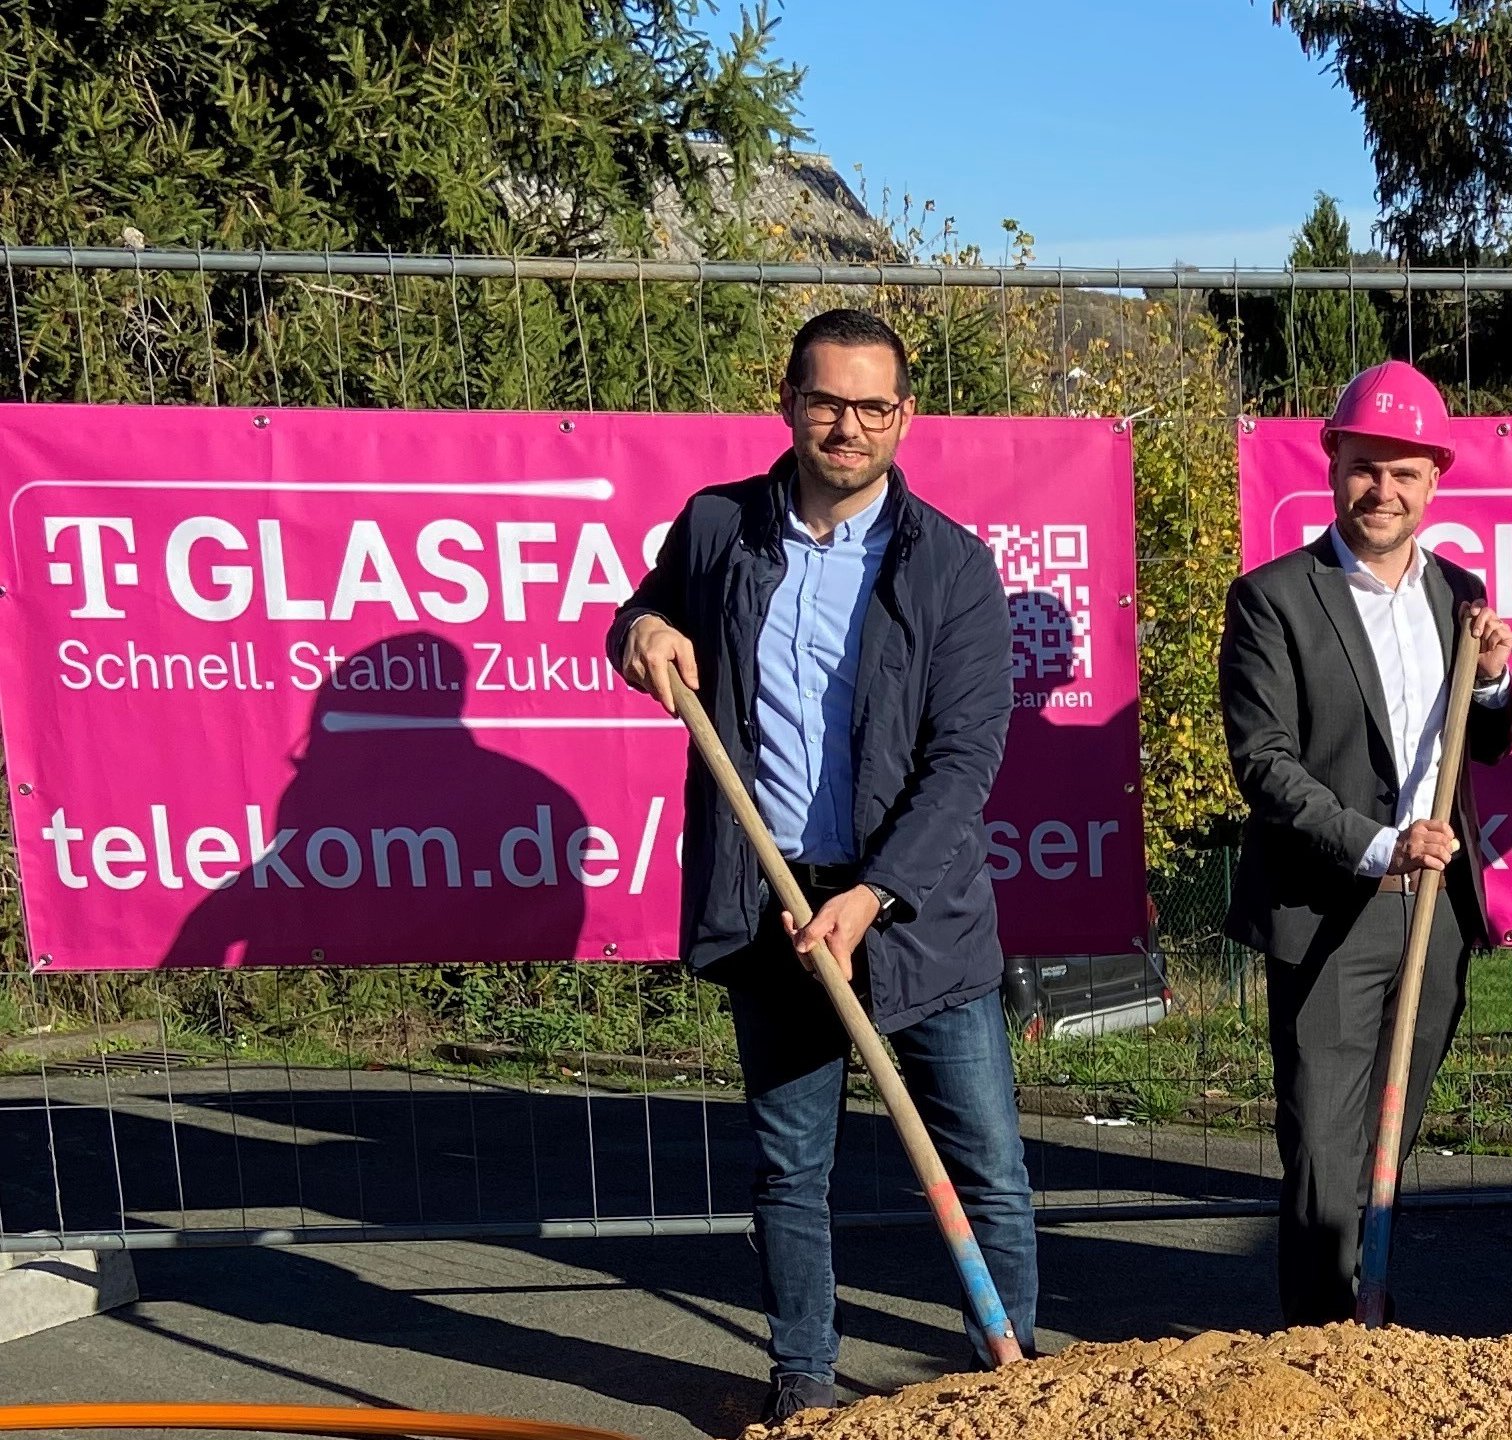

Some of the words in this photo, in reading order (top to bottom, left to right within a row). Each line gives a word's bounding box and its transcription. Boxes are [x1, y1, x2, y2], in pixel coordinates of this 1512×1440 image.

[165, 515, 674, 623] GLASFA
[58, 640, 275, 691] Schnell.
[289, 640, 460, 692] Stabil.
[1011, 691, 1093, 708] cannen
